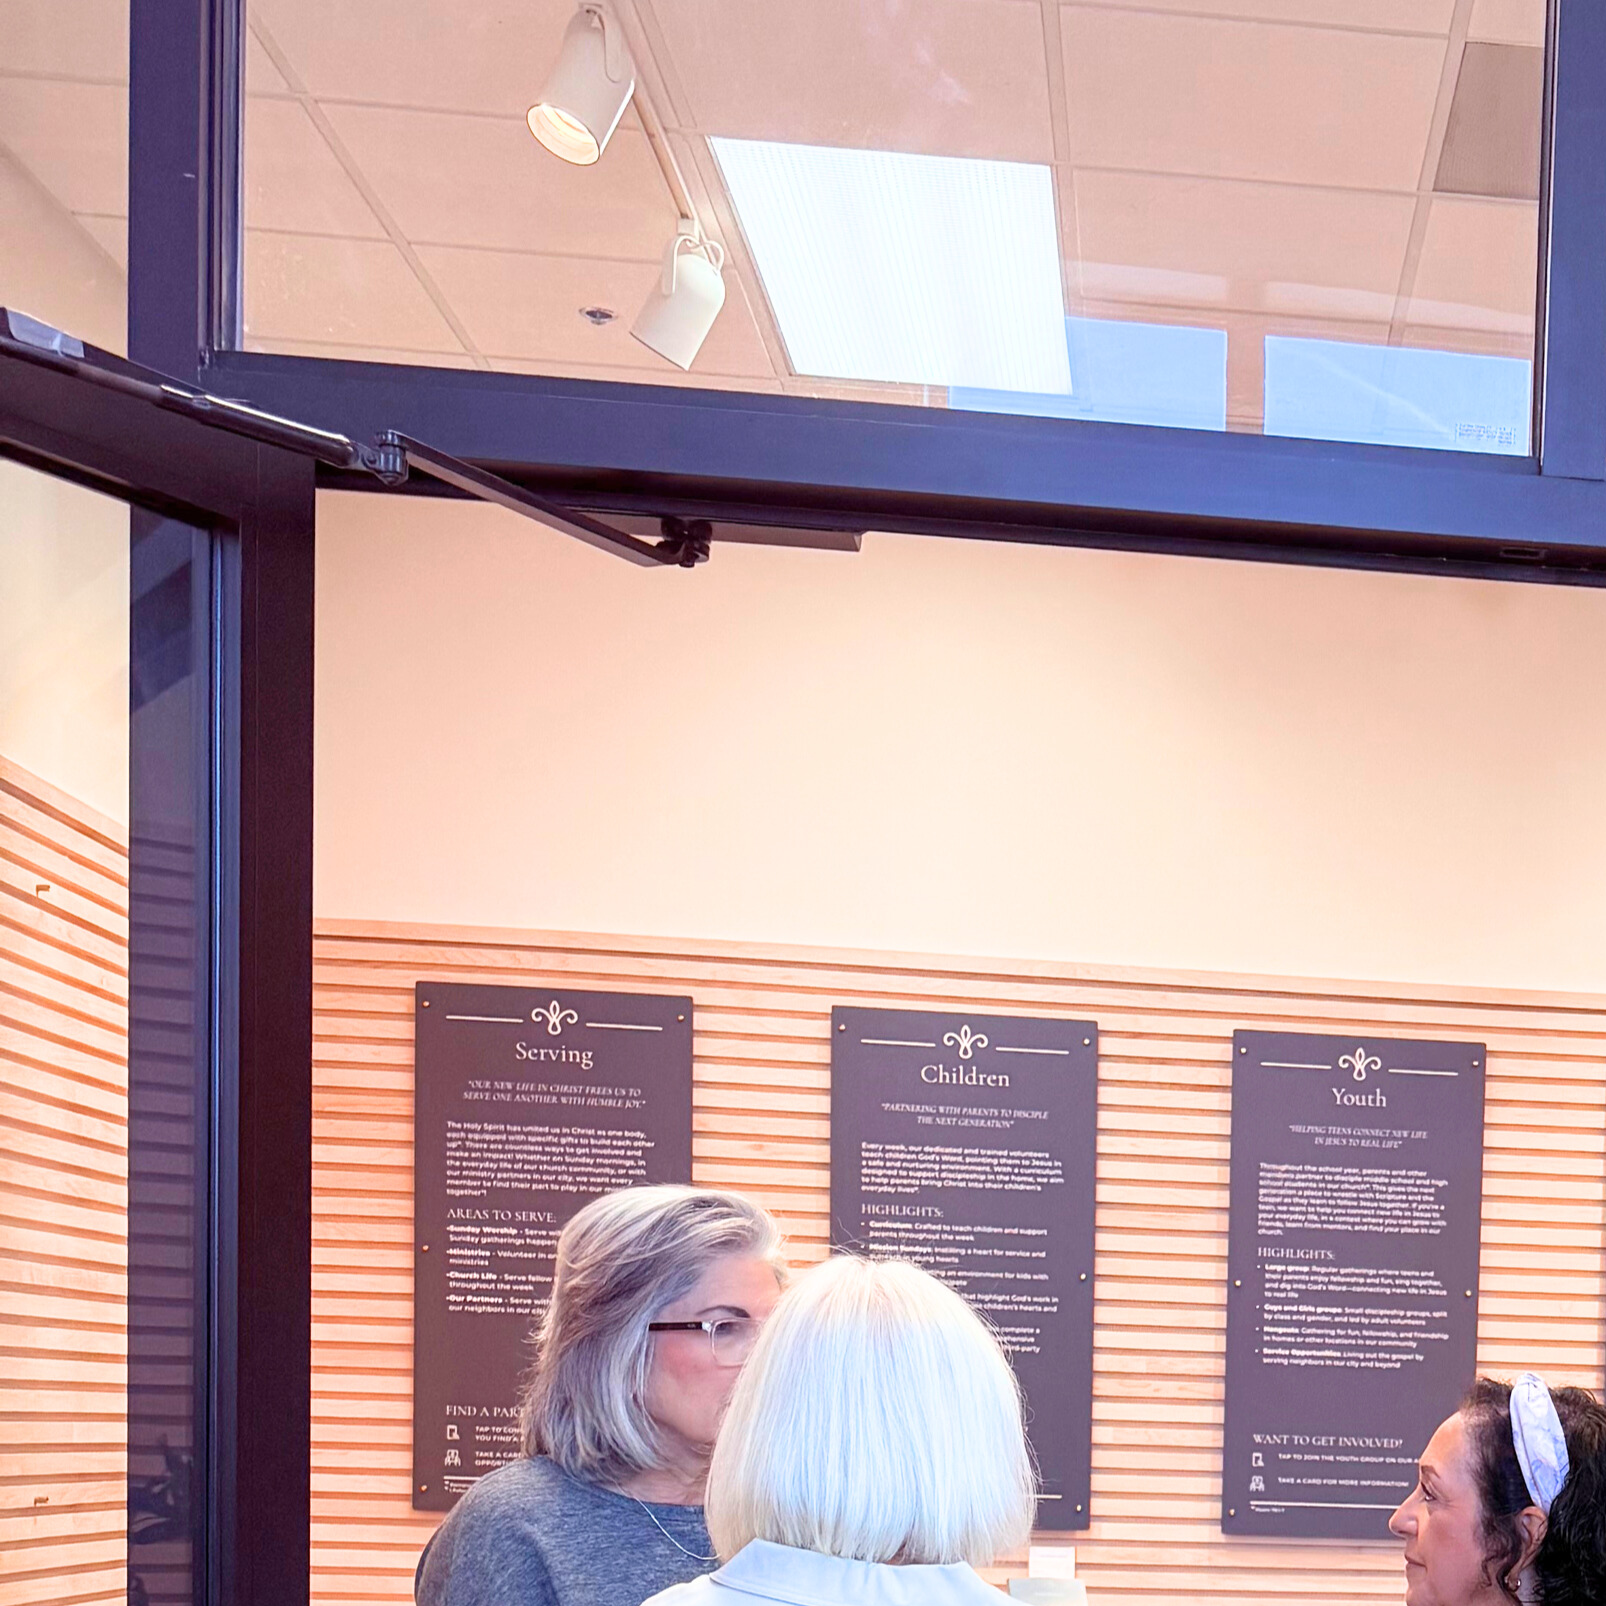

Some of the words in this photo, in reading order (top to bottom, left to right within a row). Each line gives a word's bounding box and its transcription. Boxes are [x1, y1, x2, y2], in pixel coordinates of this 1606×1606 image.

[515, 1042, 594, 1070] Serving
[920, 1063, 1010, 1087] Children
[1331, 1086, 1387, 1106] Youth
[446, 1208, 489, 1219] AREAS
[492, 1210, 511, 1220] TO
[514, 1211, 556, 1222] SERVE:
[445, 1404, 476, 1416] FIND
[479, 1406, 489, 1416] A
[1253, 1434, 1289, 1444] WANT
[1292, 1435, 1310, 1445] TO
[1311, 1436, 1335, 1446] GET
[1338, 1437, 1403, 1448] INVOLVED?
